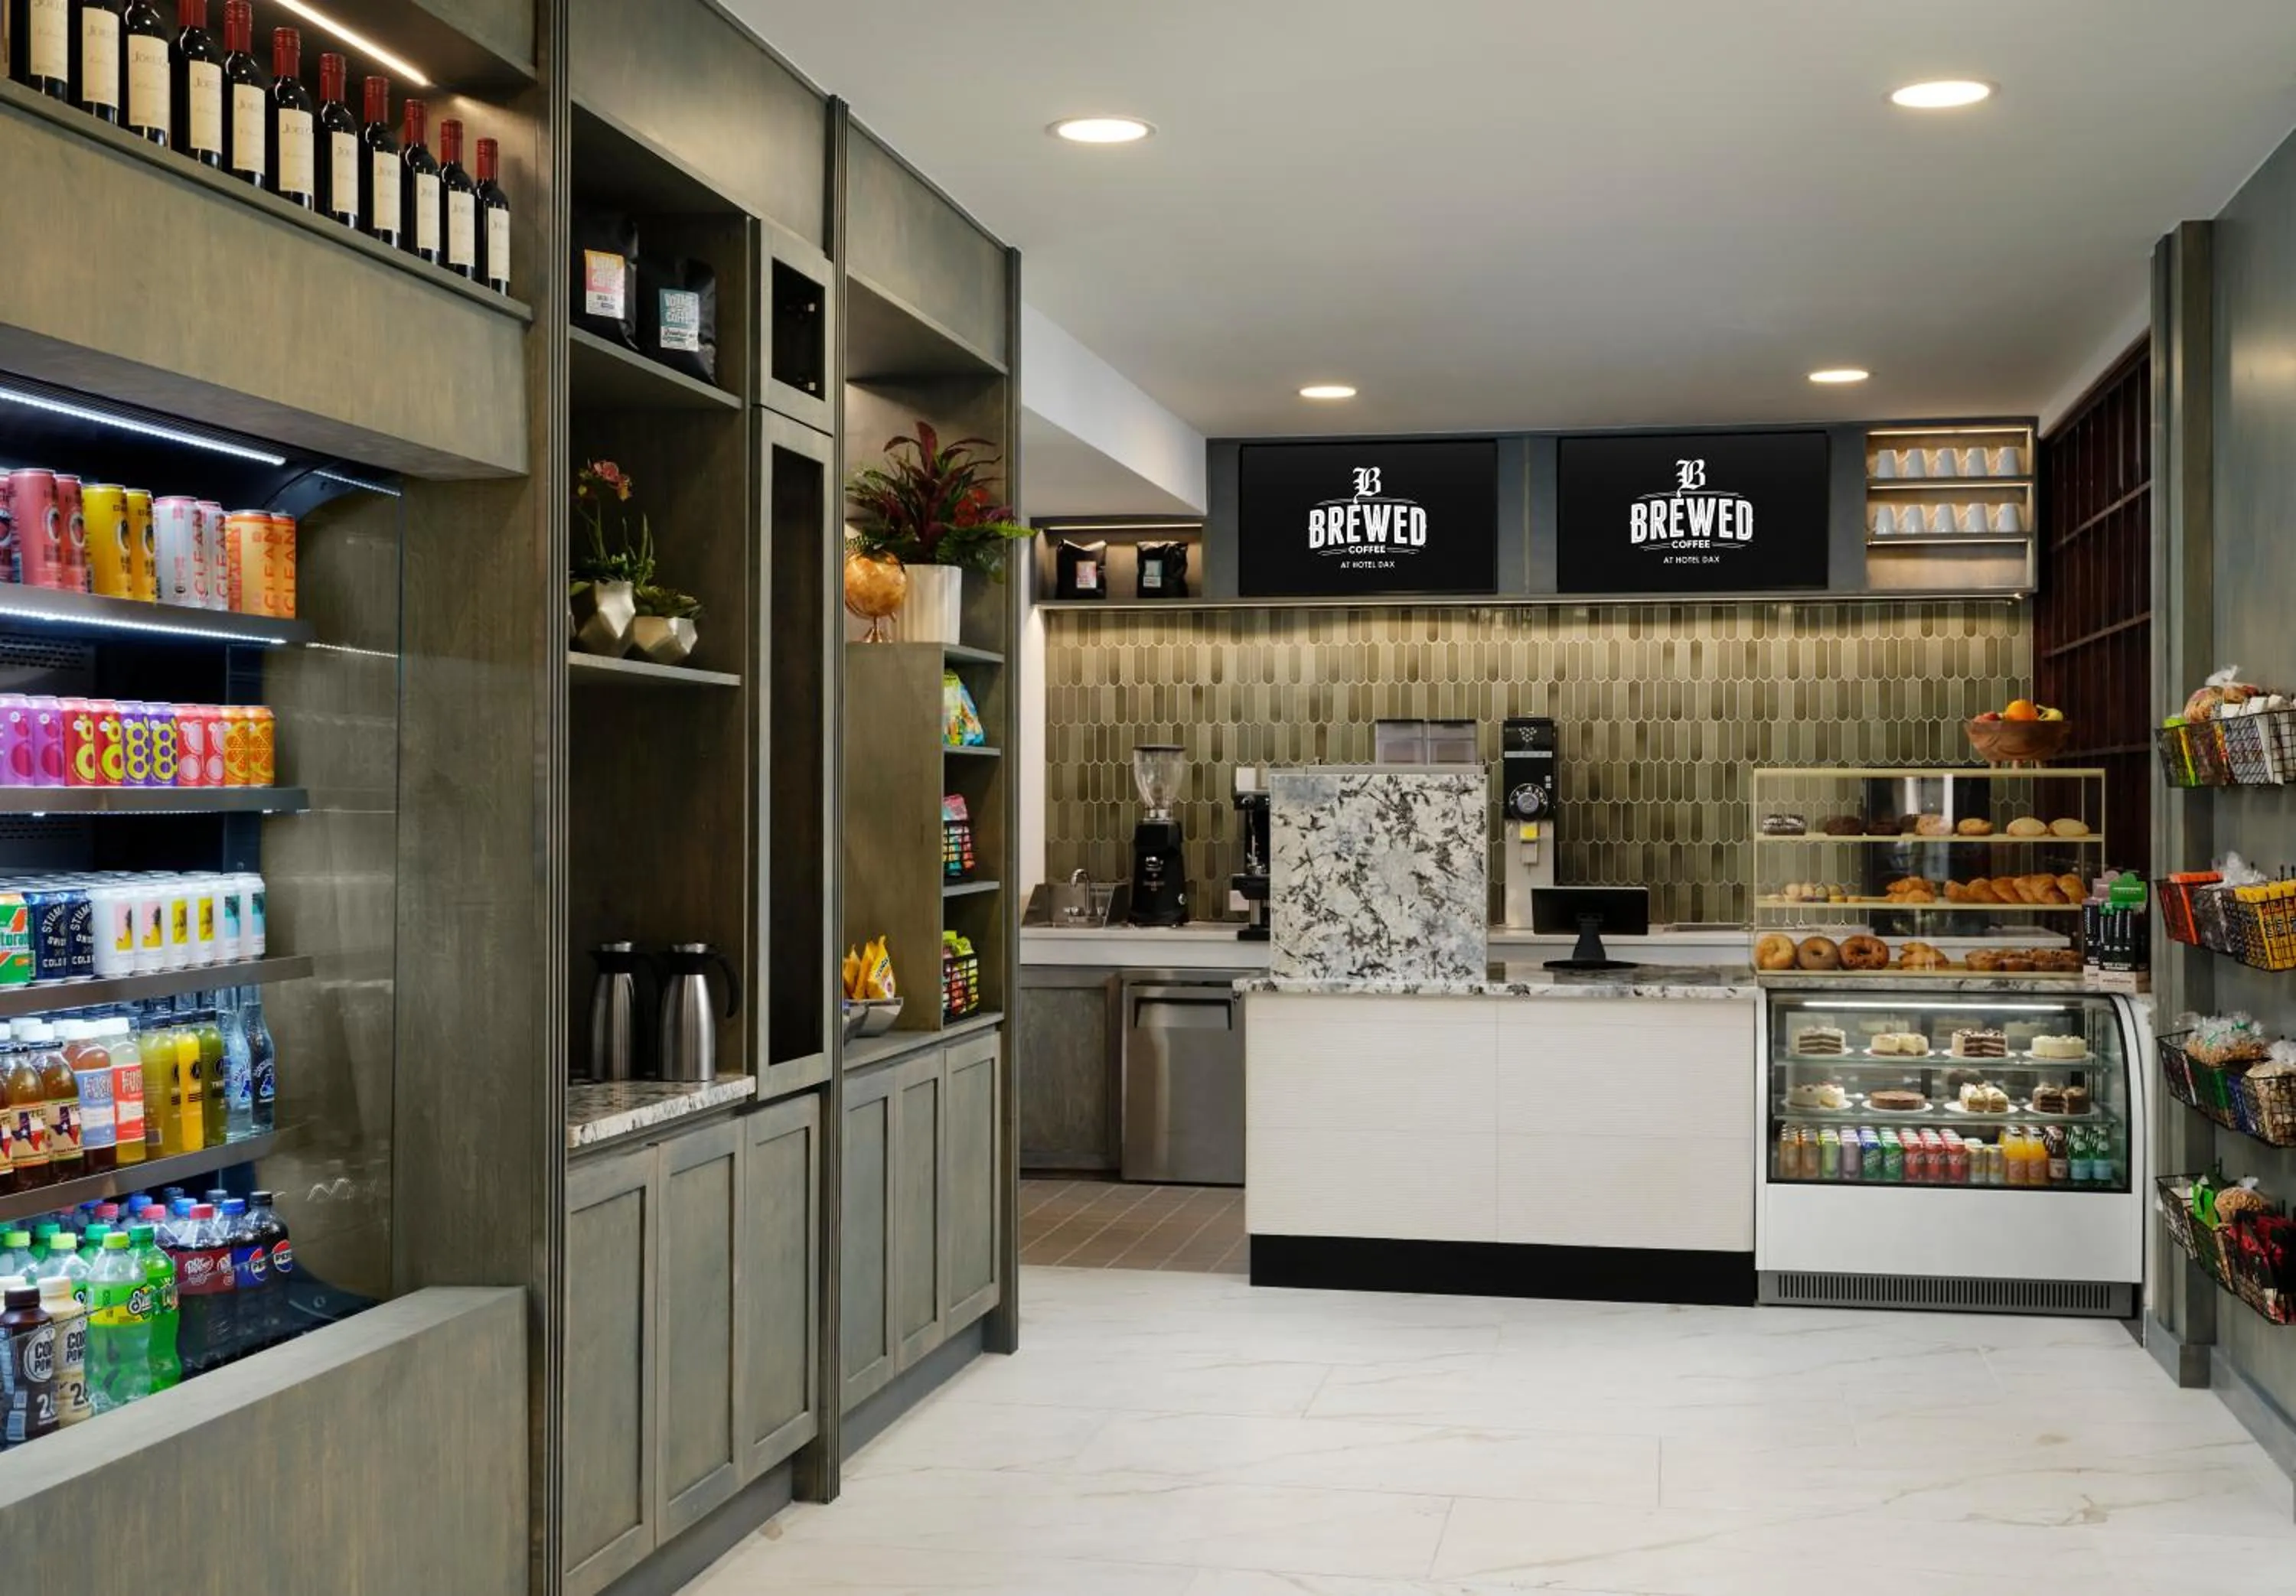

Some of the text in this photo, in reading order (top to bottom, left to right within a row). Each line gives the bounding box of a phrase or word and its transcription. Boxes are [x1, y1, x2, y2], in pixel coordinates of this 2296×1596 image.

[1352, 467, 1381, 505] B
[1675, 459, 1706, 498] B
[1309, 504, 1427, 549] BREWED
[1630, 497, 1753, 544] BREWED
[1348, 545, 1386, 554] COFFEE
[1671, 539, 1711, 549] COFFEE
[1378, 560, 1395, 568] DAX
[1702, 555, 1720, 564] DAX
